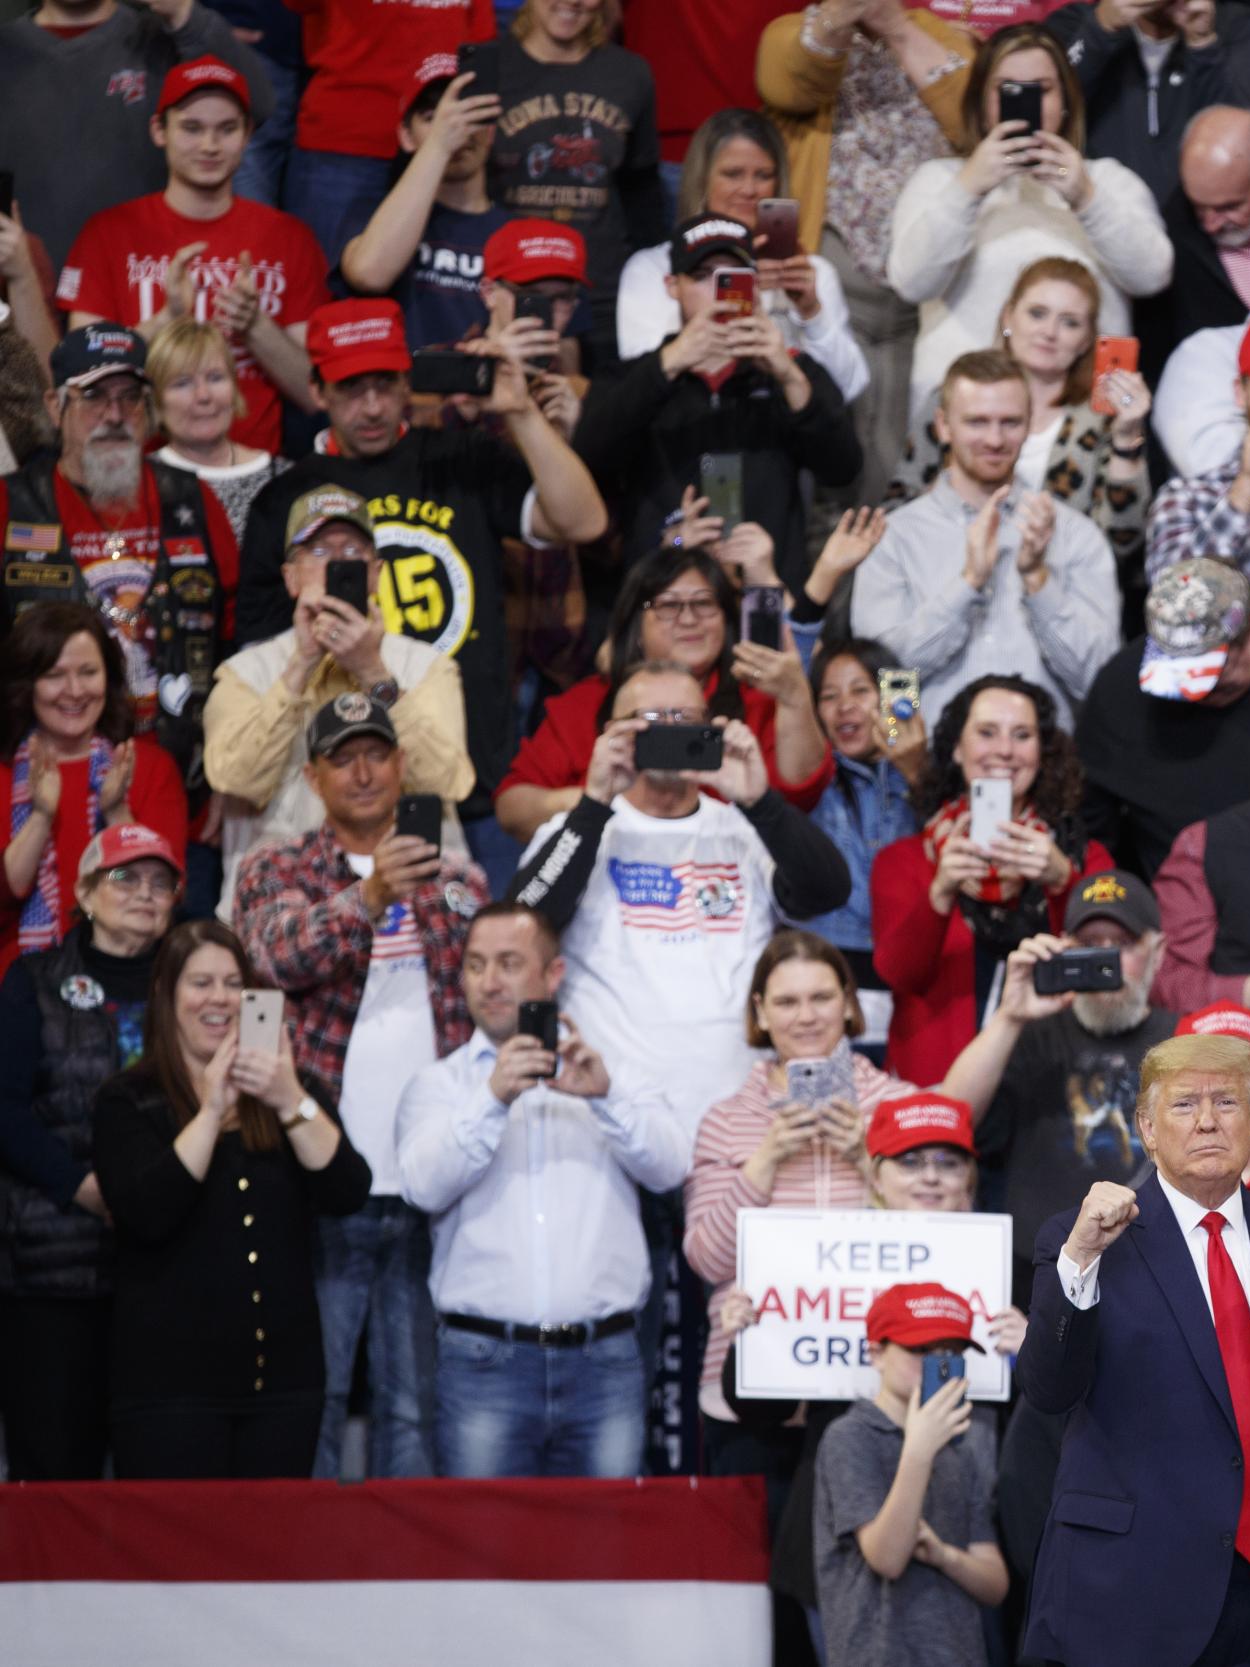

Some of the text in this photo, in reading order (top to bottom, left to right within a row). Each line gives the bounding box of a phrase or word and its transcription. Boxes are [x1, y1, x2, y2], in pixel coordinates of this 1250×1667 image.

[500, 93, 561, 136] IOWA
[406, 498, 455, 530] FOR
[816, 1240, 931, 1273] KEEP
[755, 1284, 995, 1324] AMEA
[790, 1335, 874, 1367] GRE
